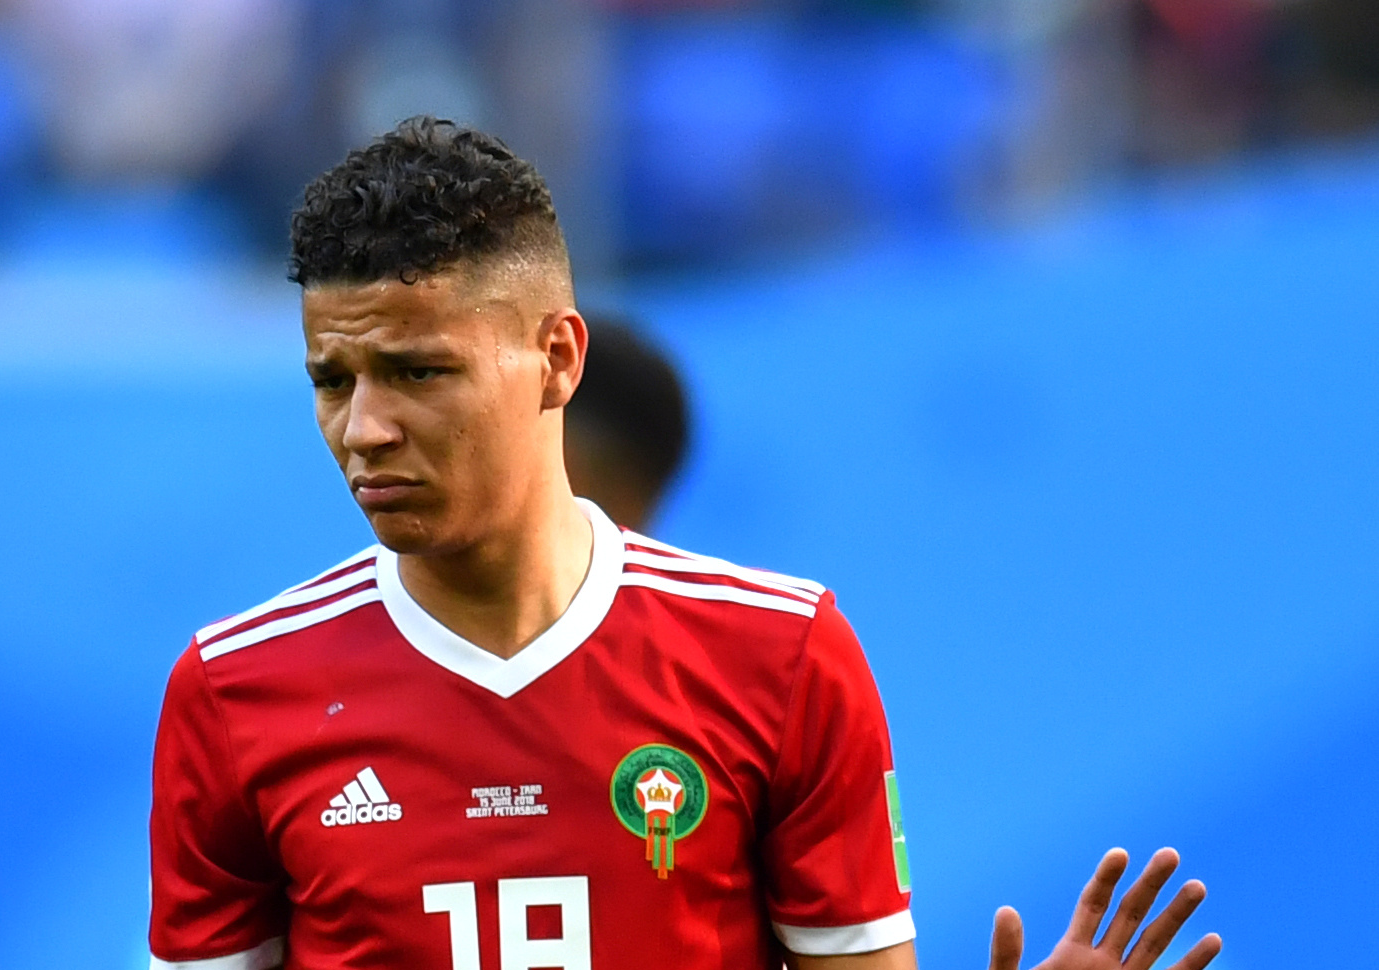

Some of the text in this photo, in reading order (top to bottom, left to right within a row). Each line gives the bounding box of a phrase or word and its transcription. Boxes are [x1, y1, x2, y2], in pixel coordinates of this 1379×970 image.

[471, 787, 511, 798] MOROCCO
[519, 784, 542, 795] IRAN
[480, 796, 535, 807] 15 JUNE 2018
[321, 802, 402, 827] adidas
[466, 804, 549, 818] SAINT PETERSBURG
